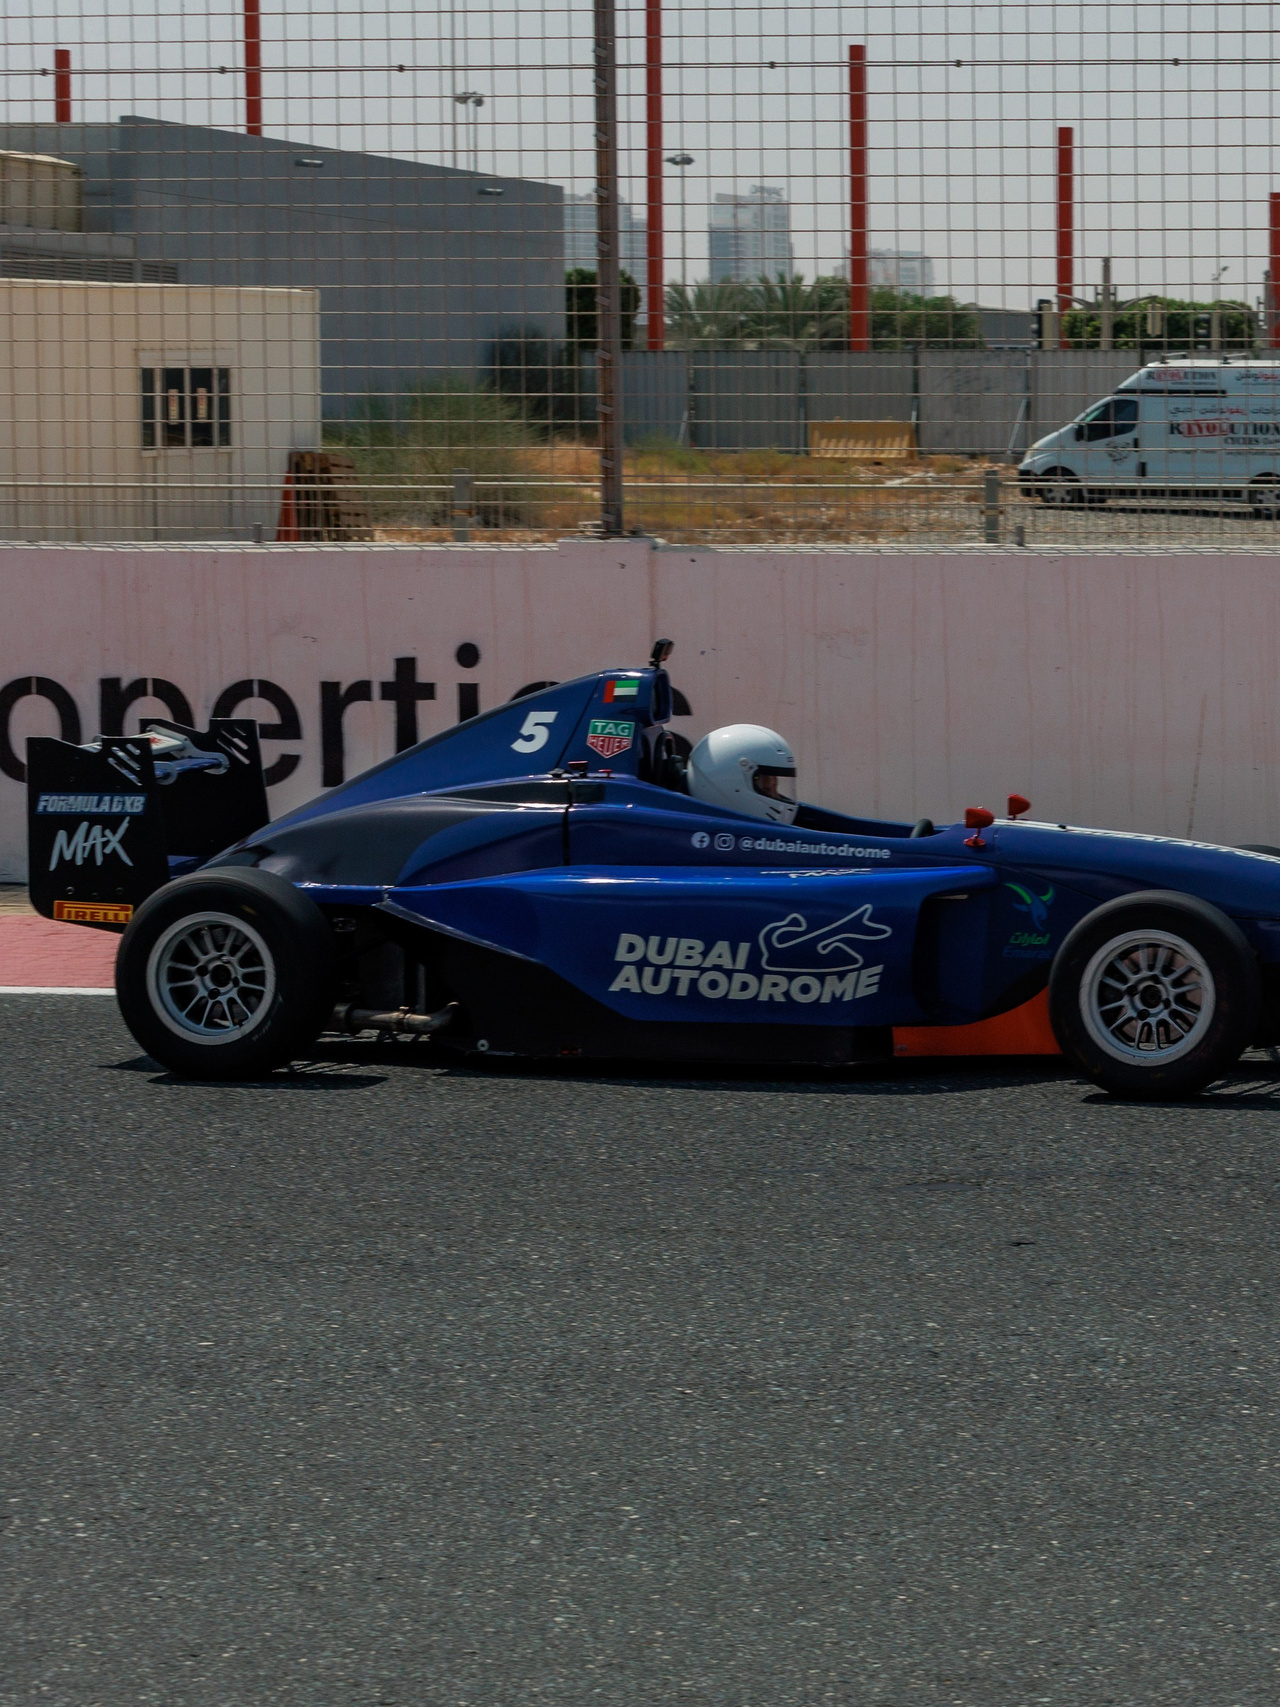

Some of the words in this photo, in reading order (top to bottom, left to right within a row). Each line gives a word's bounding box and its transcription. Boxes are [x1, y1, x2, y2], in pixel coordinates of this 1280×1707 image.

[510, 711, 559, 754] 5
[594, 722, 631, 736] TAG
[588, 736, 631, 756] HEUER
[49, 816, 134, 871] MAX
[738, 836, 892, 859] @dubaiautodrome
[54, 901, 133, 923] PIRELLI
[614, 933, 751, 970] DUBAI
[608, 964, 885, 1004] AUTODROME
